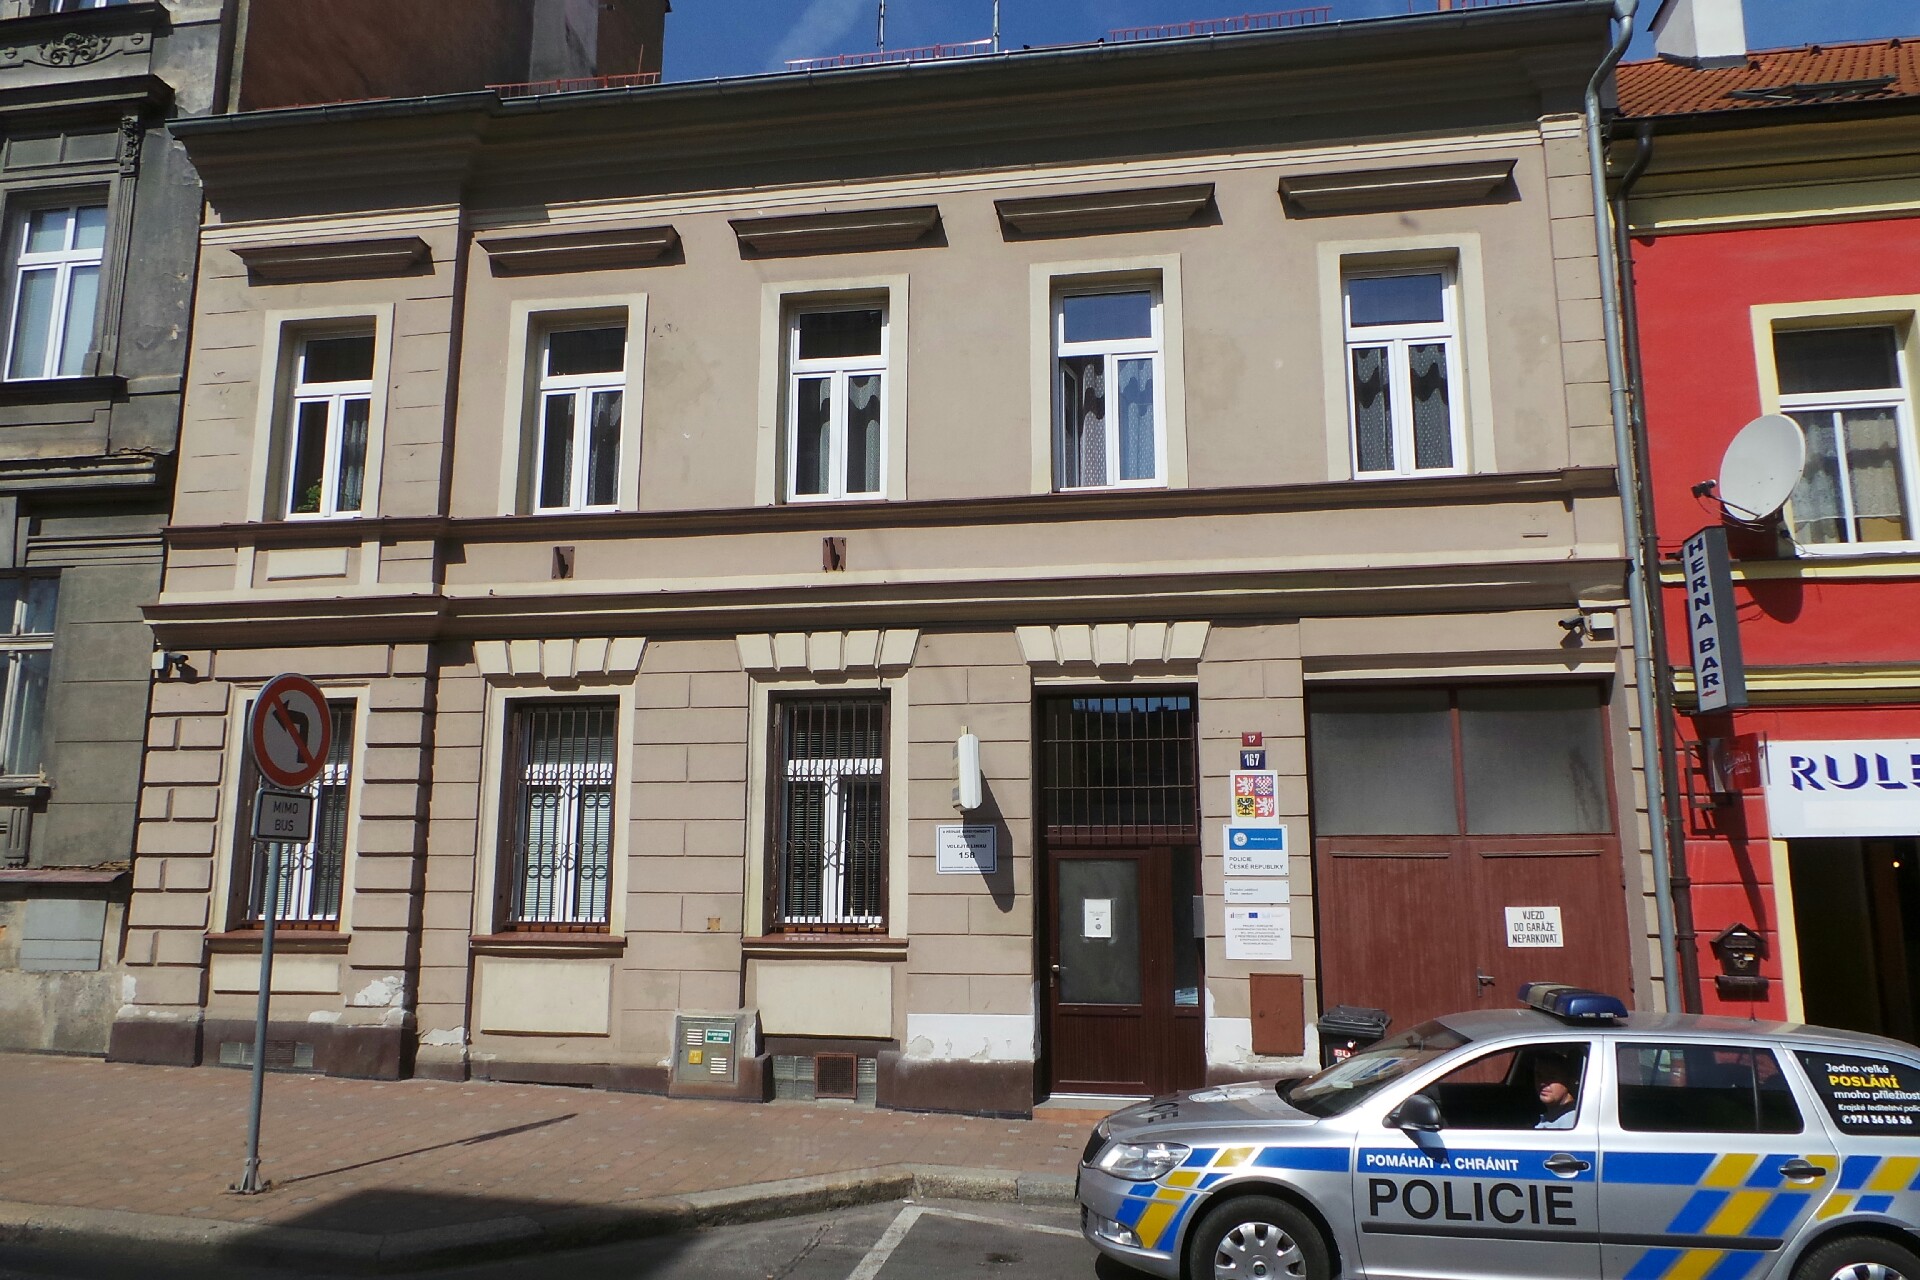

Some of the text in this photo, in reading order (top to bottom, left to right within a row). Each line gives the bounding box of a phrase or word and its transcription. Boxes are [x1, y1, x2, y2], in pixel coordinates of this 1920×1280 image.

[1688, 537, 1720, 690] HERNA BAR
[1247, 735, 1256, 744] 17
[1244, 753, 1260, 767] 167
[273, 801, 299, 814] MIMO
[274, 819, 294, 832] BUS
[958, 851, 976, 859] 158
[1522, 910, 1545, 920] VJEZD
[1513, 920, 1555, 932] DO GARÁŽE
[1512, 933, 1558, 944] NEPARKOVAT
[1825, 1063, 1860, 1073] Jedno
[1828, 1074, 1900, 1088] POSLÁNÍ
[1833, 1090, 1871, 1099] mnoho
[1838, 1103, 1866, 1112] Krajské
[1850, 1115, 1913, 1125] 974 36 36 36
[1366, 1152, 1519, 1171] POMÁHAT A CHRÁNIT
[1368, 1178, 1577, 1225] POLICIE
